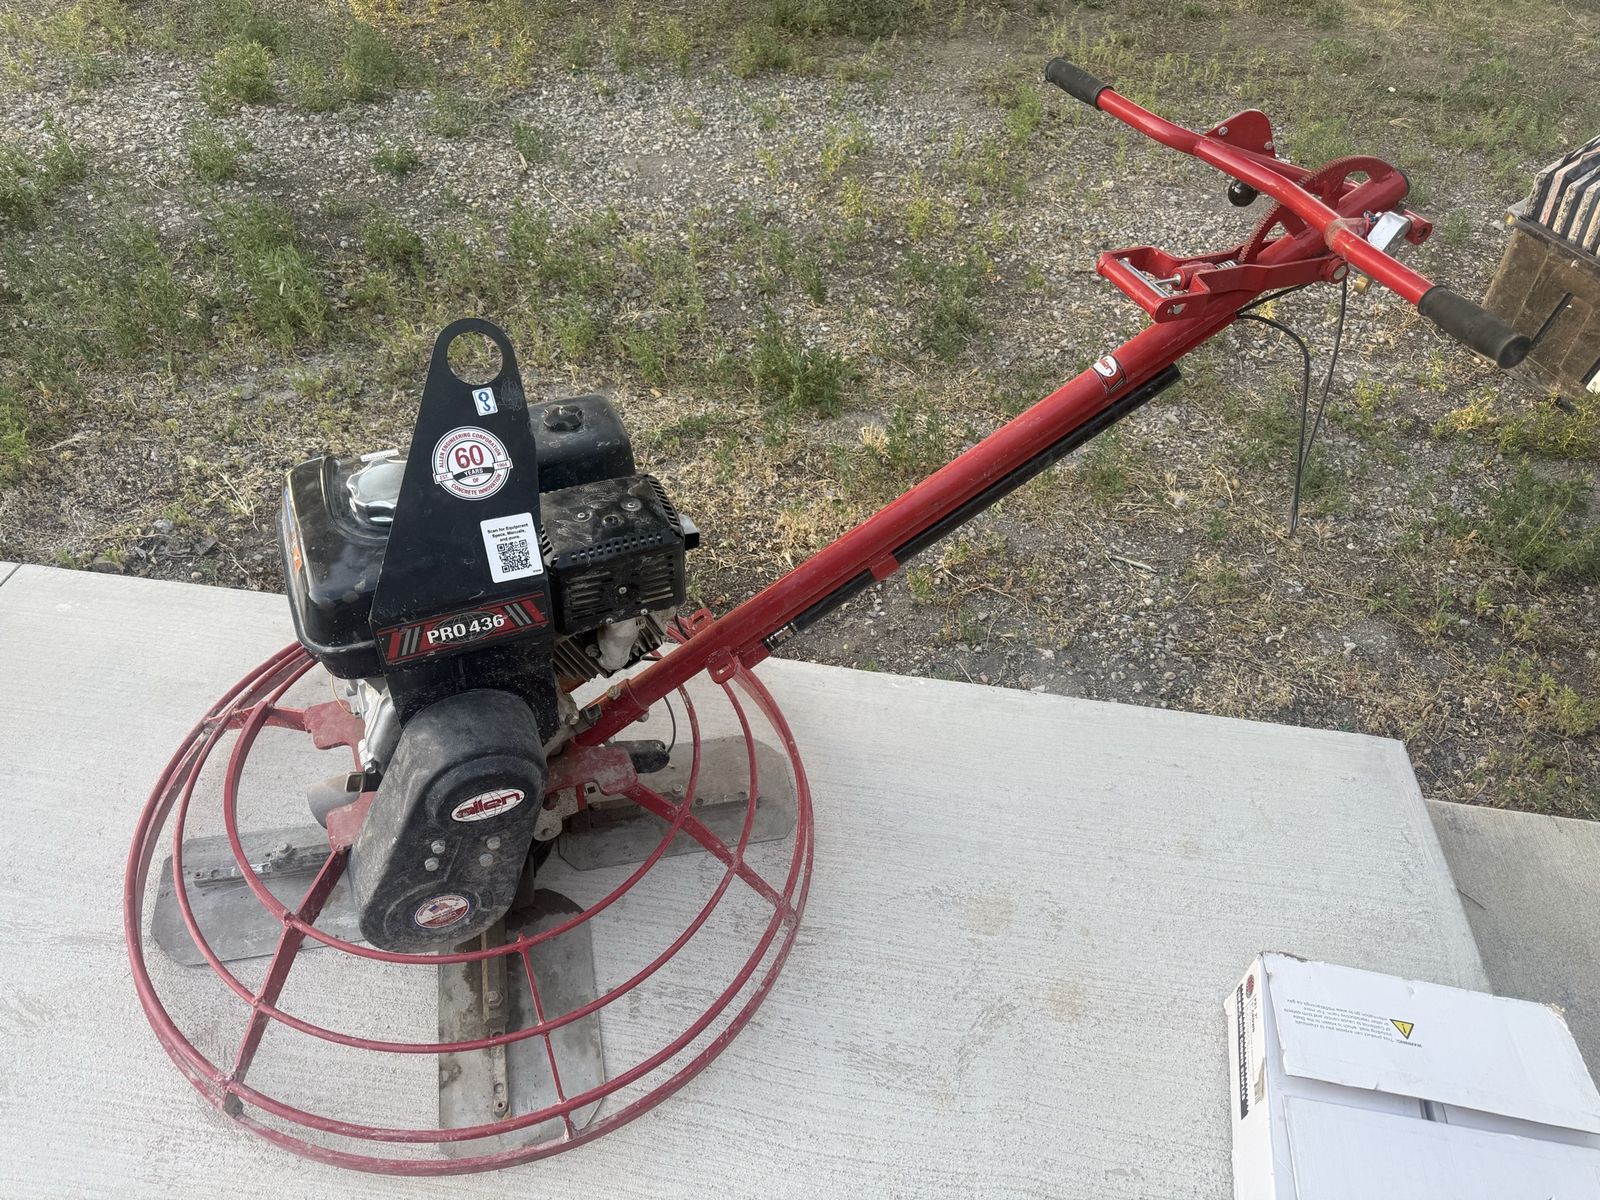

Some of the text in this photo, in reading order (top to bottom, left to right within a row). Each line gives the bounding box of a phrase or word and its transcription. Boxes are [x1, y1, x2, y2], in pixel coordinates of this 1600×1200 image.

[442, 432, 471, 454] ENGINEERING
[472, 432, 502, 456] CORPORATION
[455, 445, 484, 469] 60
[451, 473, 502, 495] CONCRETE INNOVATION
[464, 468, 484, 476] YEARS
[426, 614, 506, 644] PRO 436
[455, 792, 521, 818] allen
